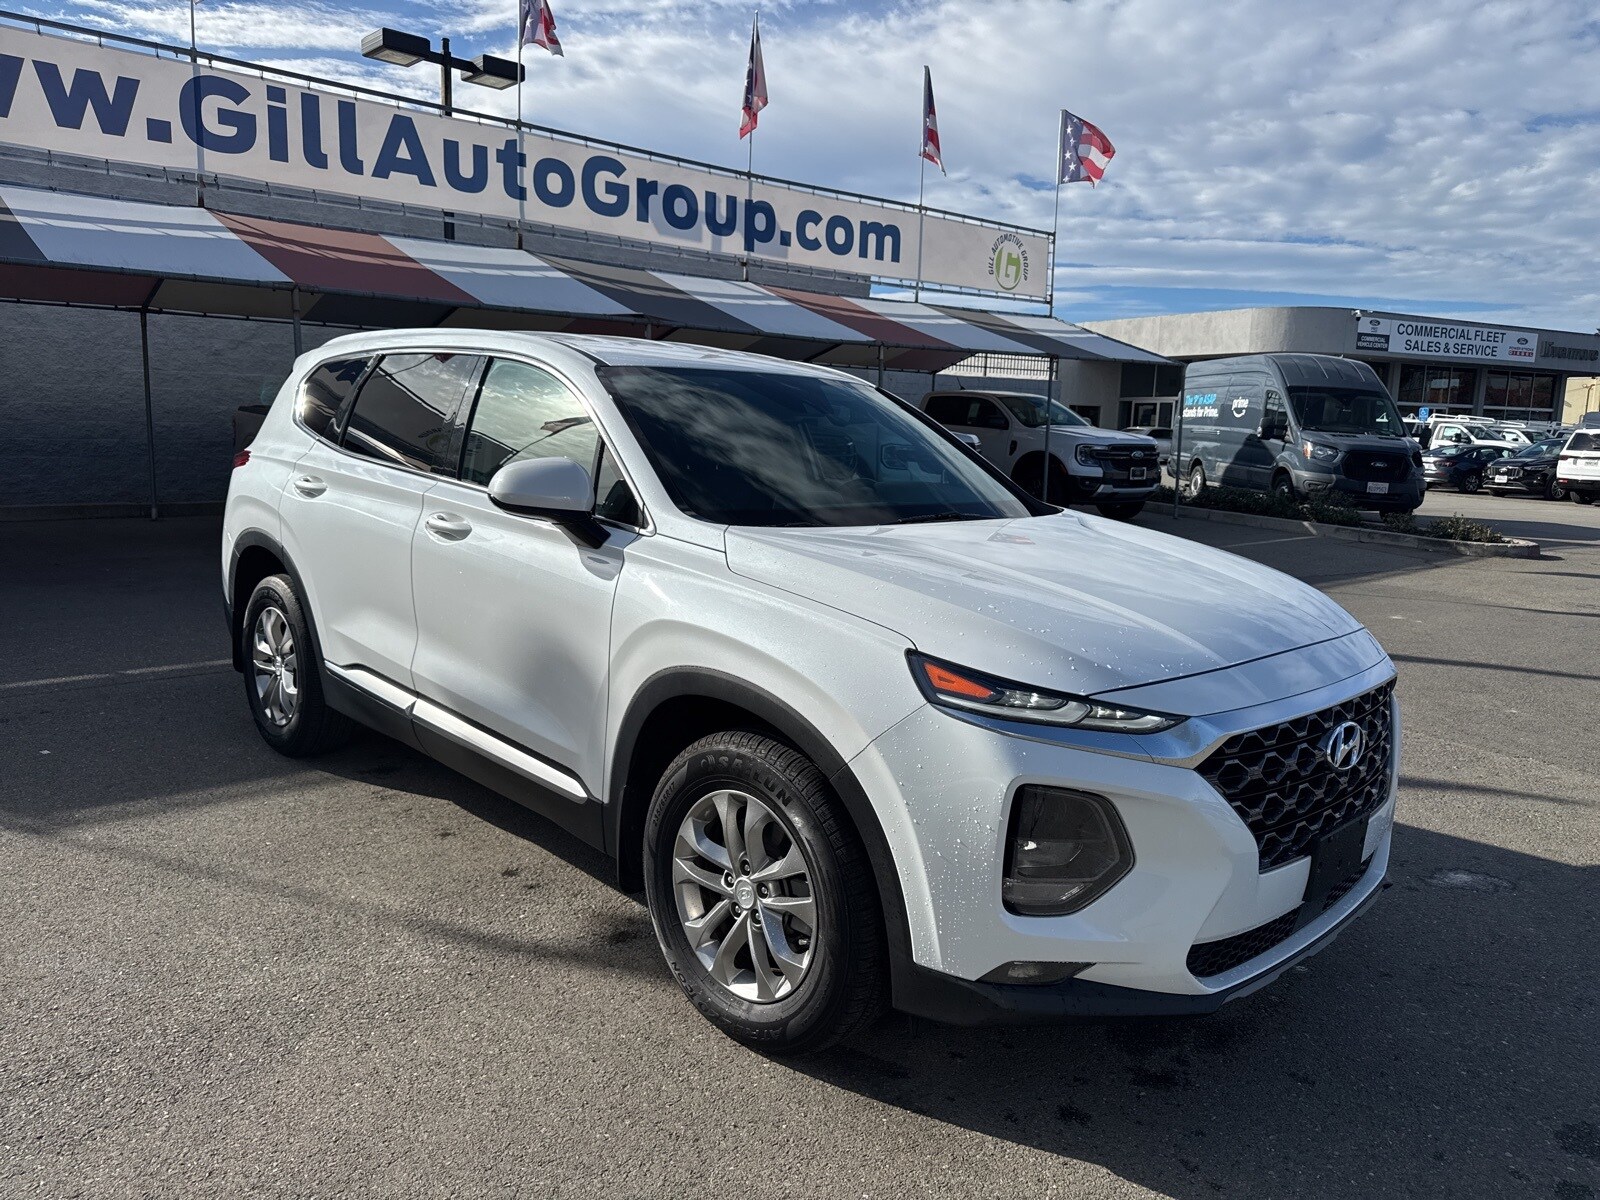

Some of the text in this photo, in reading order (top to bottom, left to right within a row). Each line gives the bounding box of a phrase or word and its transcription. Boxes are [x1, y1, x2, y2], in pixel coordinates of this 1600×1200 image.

[0, 53, 901, 263] w.GillAutoGroup.com
[991, 233, 1024, 255] AUTOMOTIVE
[1021, 250, 1029, 281] GROUP
[1361, 335, 1386, 343] COMMERCIAL
[1397, 323, 1472, 341] COMMERCIAL
[1474, 330, 1506, 343] FLEET
[1404, 339, 1498, 357] SALES & SERVICE
[1231, 397, 1248, 410] prime
